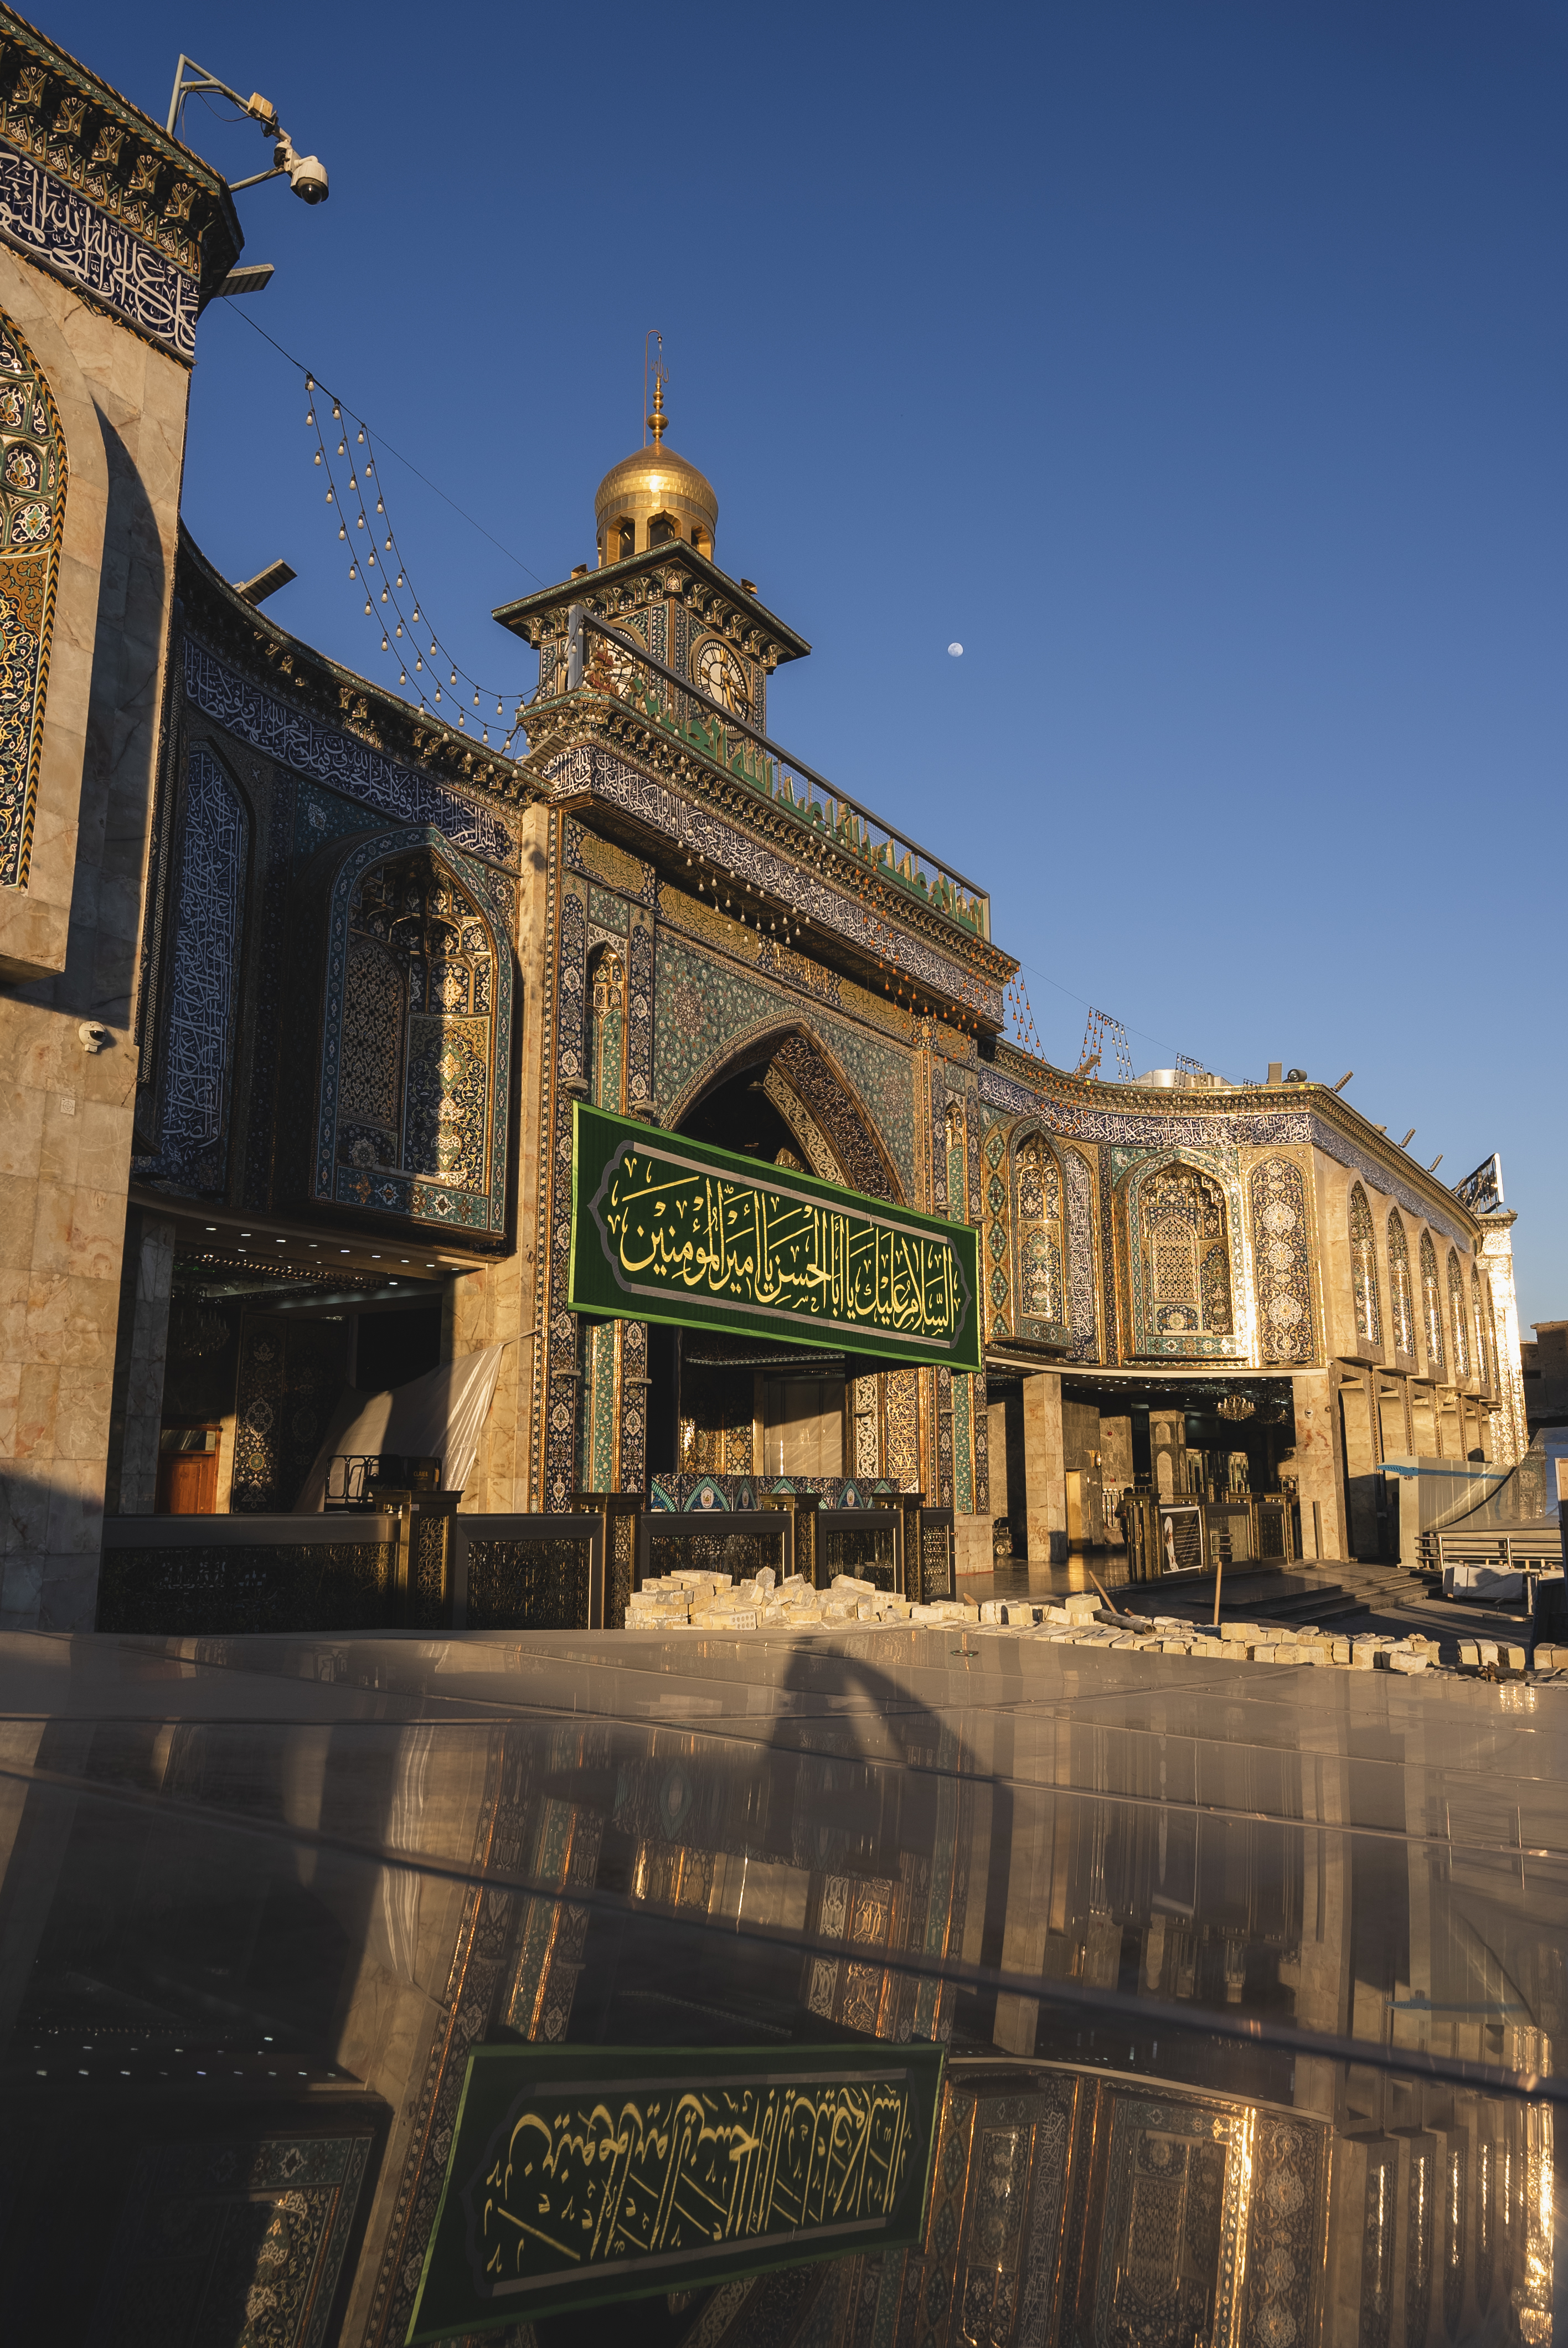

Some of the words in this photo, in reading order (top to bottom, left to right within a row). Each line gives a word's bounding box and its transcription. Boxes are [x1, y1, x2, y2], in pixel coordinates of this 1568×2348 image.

[728, 742, 773, 796] الله
[620, 1177, 725, 1286] المؤمنين
[708, 1190, 760, 1294] أمير
[755, 1208, 832, 1309] الحسن
[761, 1192, 773, 1293] يا
[831, 1213, 844, 1317] أبا
[846, 1218, 856, 1320] يا
[855, 1227, 909, 1325] عليك
[894, 1237, 955, 1333] السلام
